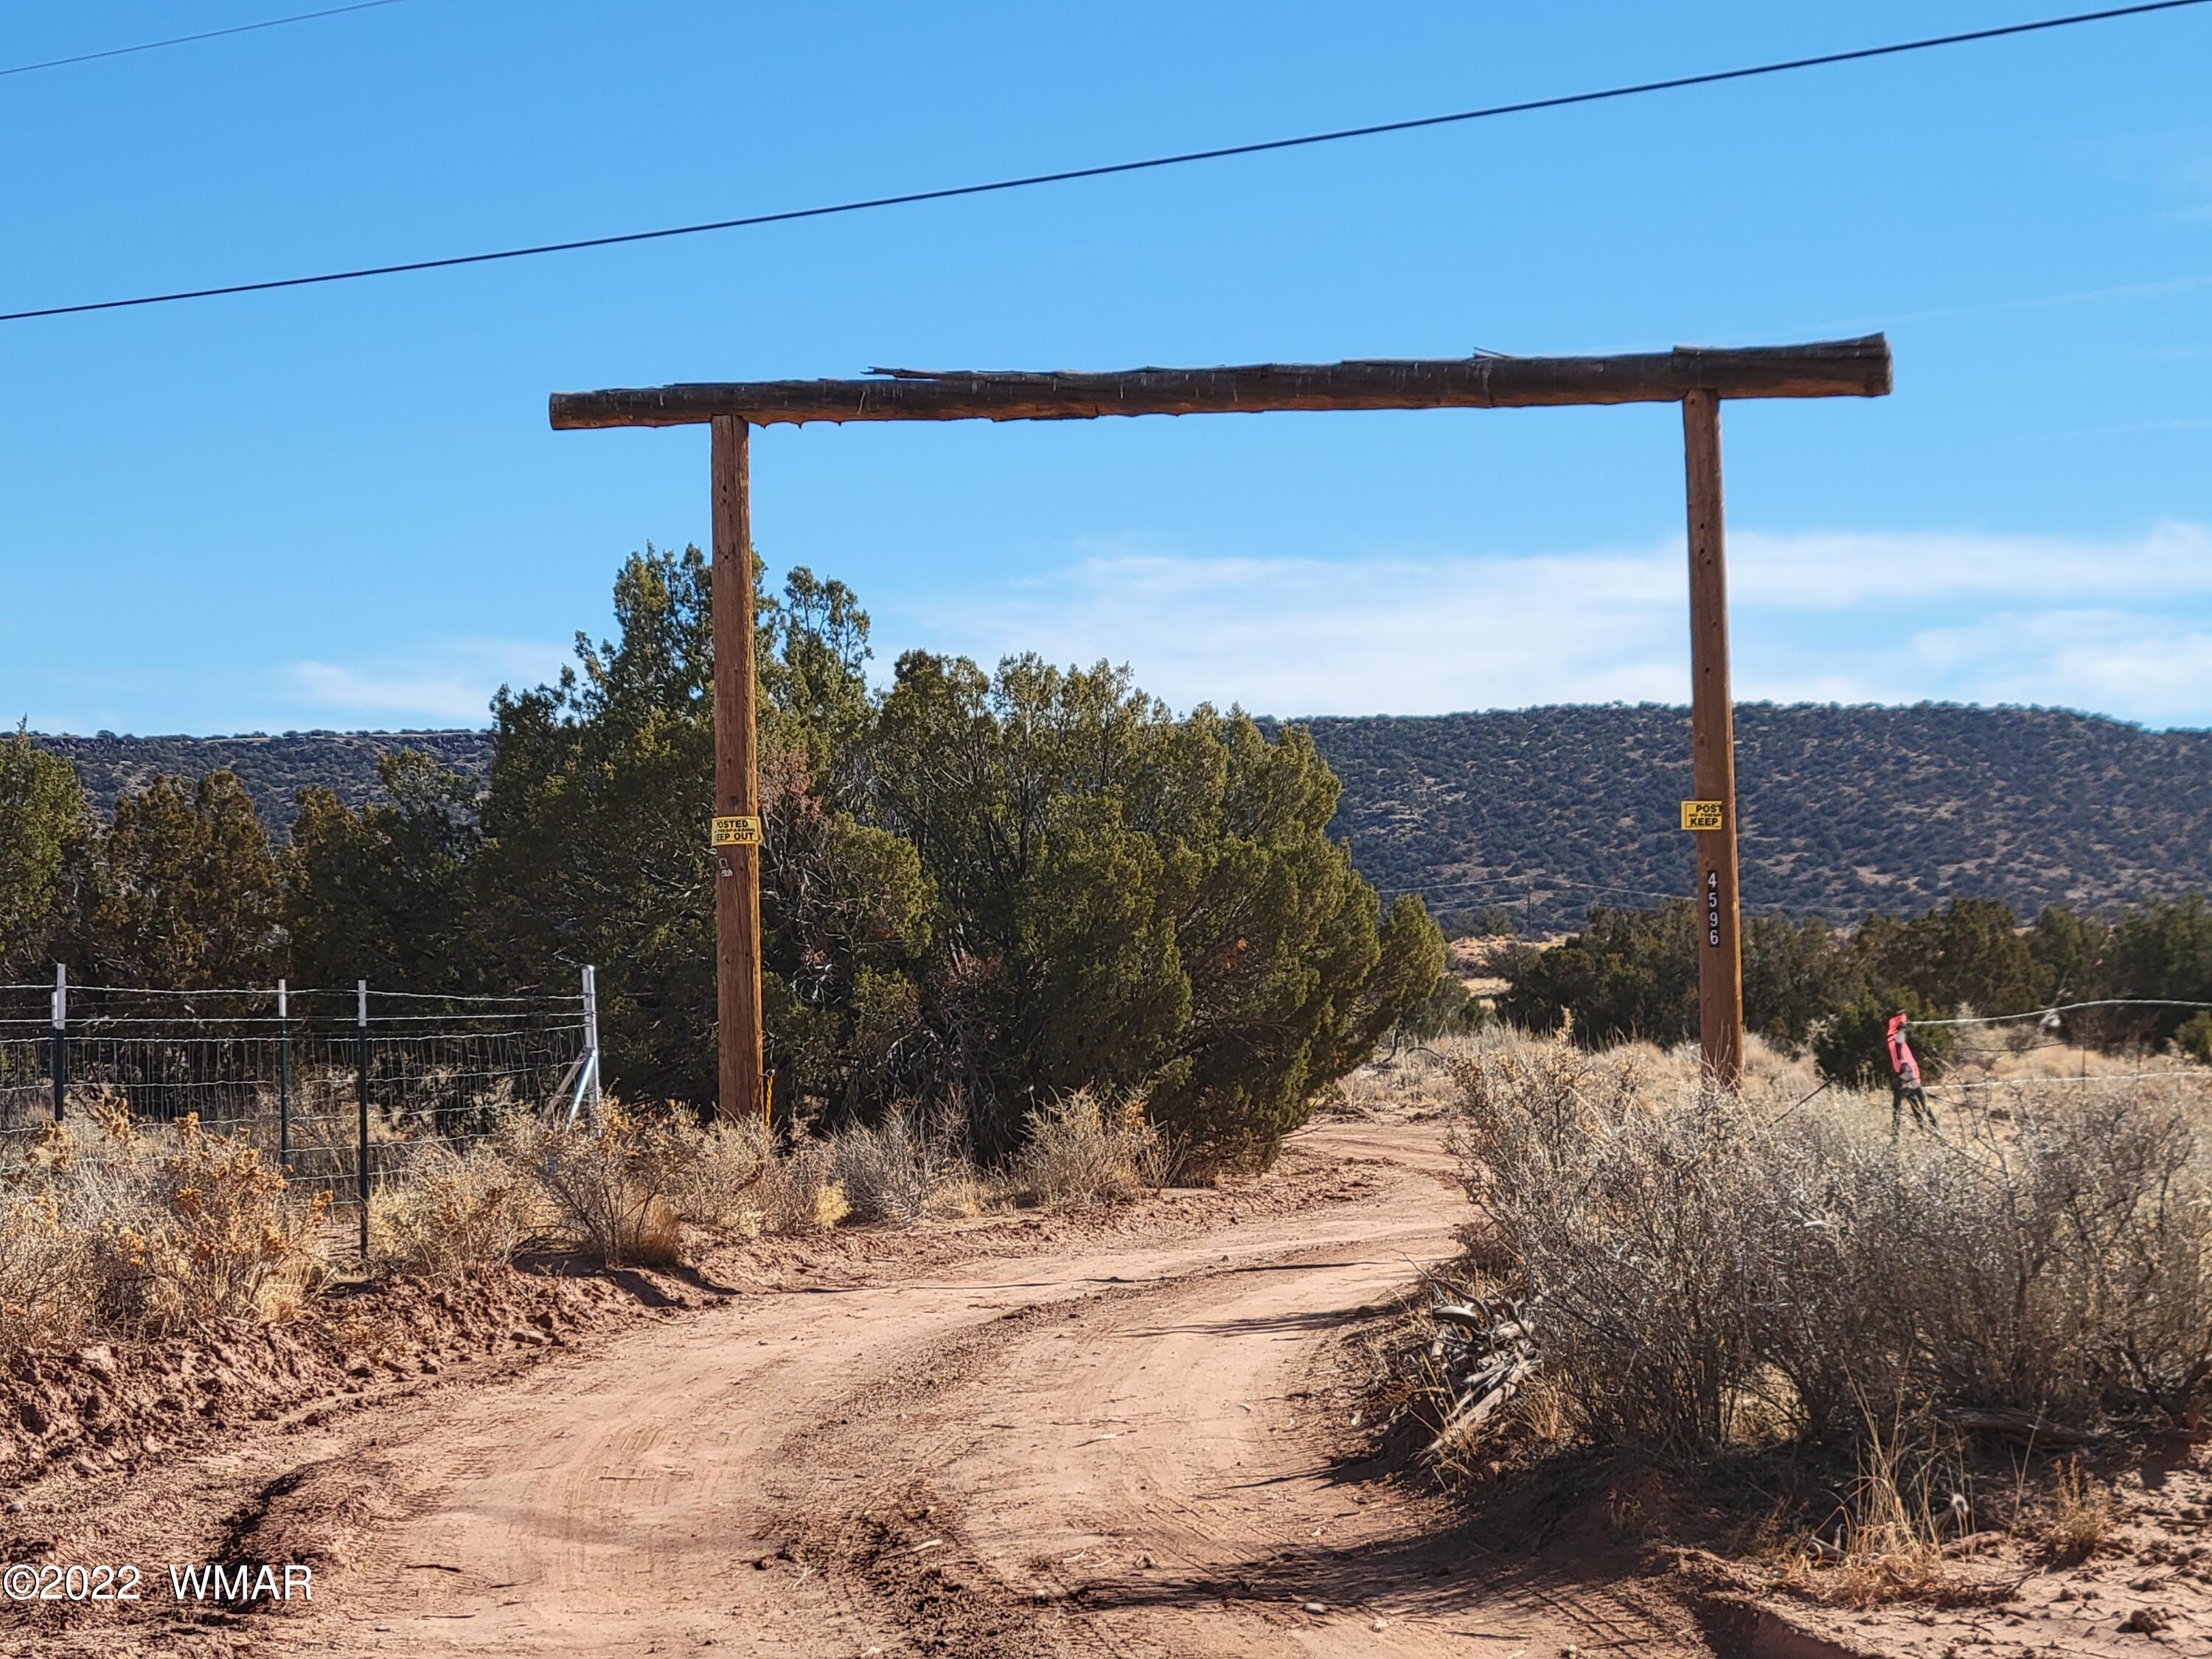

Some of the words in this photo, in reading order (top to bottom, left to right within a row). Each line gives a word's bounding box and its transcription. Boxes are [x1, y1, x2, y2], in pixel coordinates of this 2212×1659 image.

[1691, 818, 1718, 826] KEEP
[715, 832, 730, 841] EEP
[734, 832, 754, 841] OUT
[1708, 872, 1719, 945] 4596
